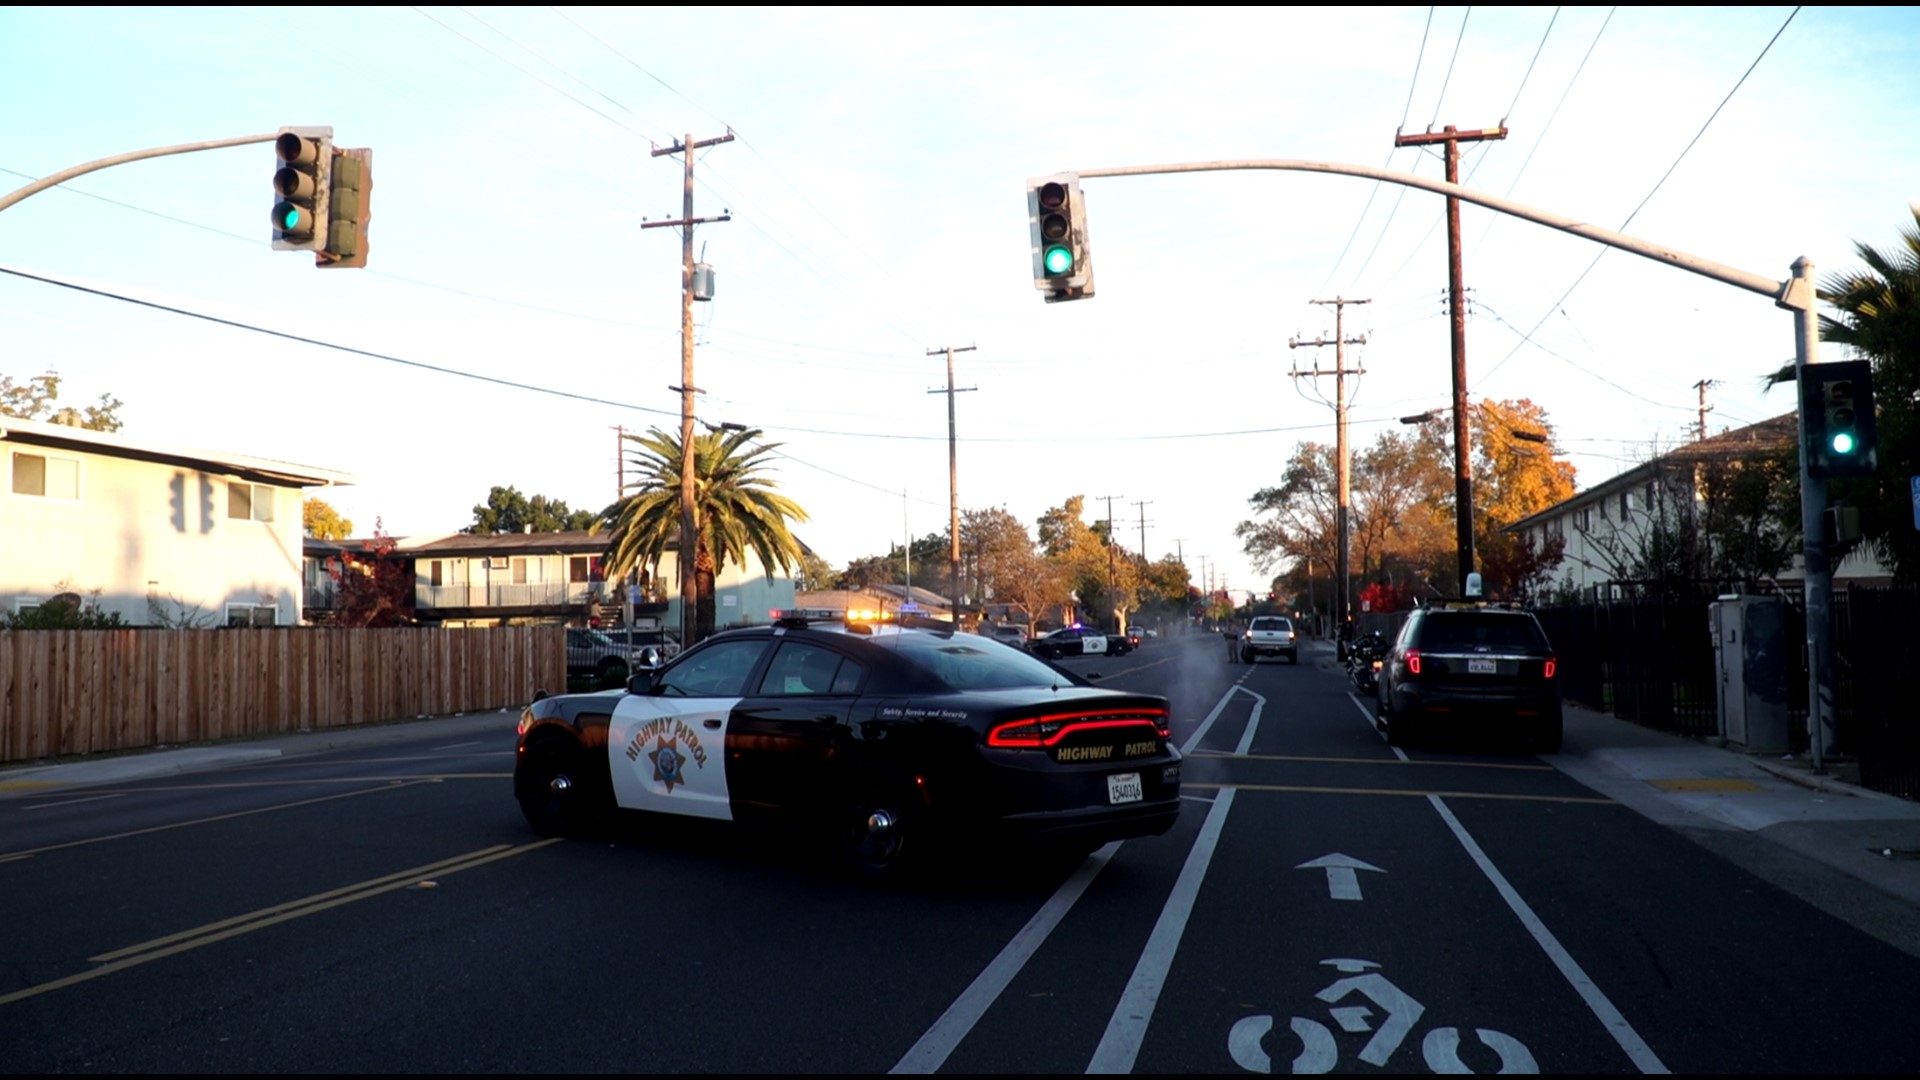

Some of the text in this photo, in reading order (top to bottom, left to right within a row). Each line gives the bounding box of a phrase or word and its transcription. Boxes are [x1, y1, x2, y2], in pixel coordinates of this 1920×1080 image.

[927, 709, 940, 717] and
[625, 716, 707, 769] HIGHWAY PATROL
[1057, 741, 1157, 761] HIGHWAY PATROL
[1111, 783, 1141, 802] 1540316
